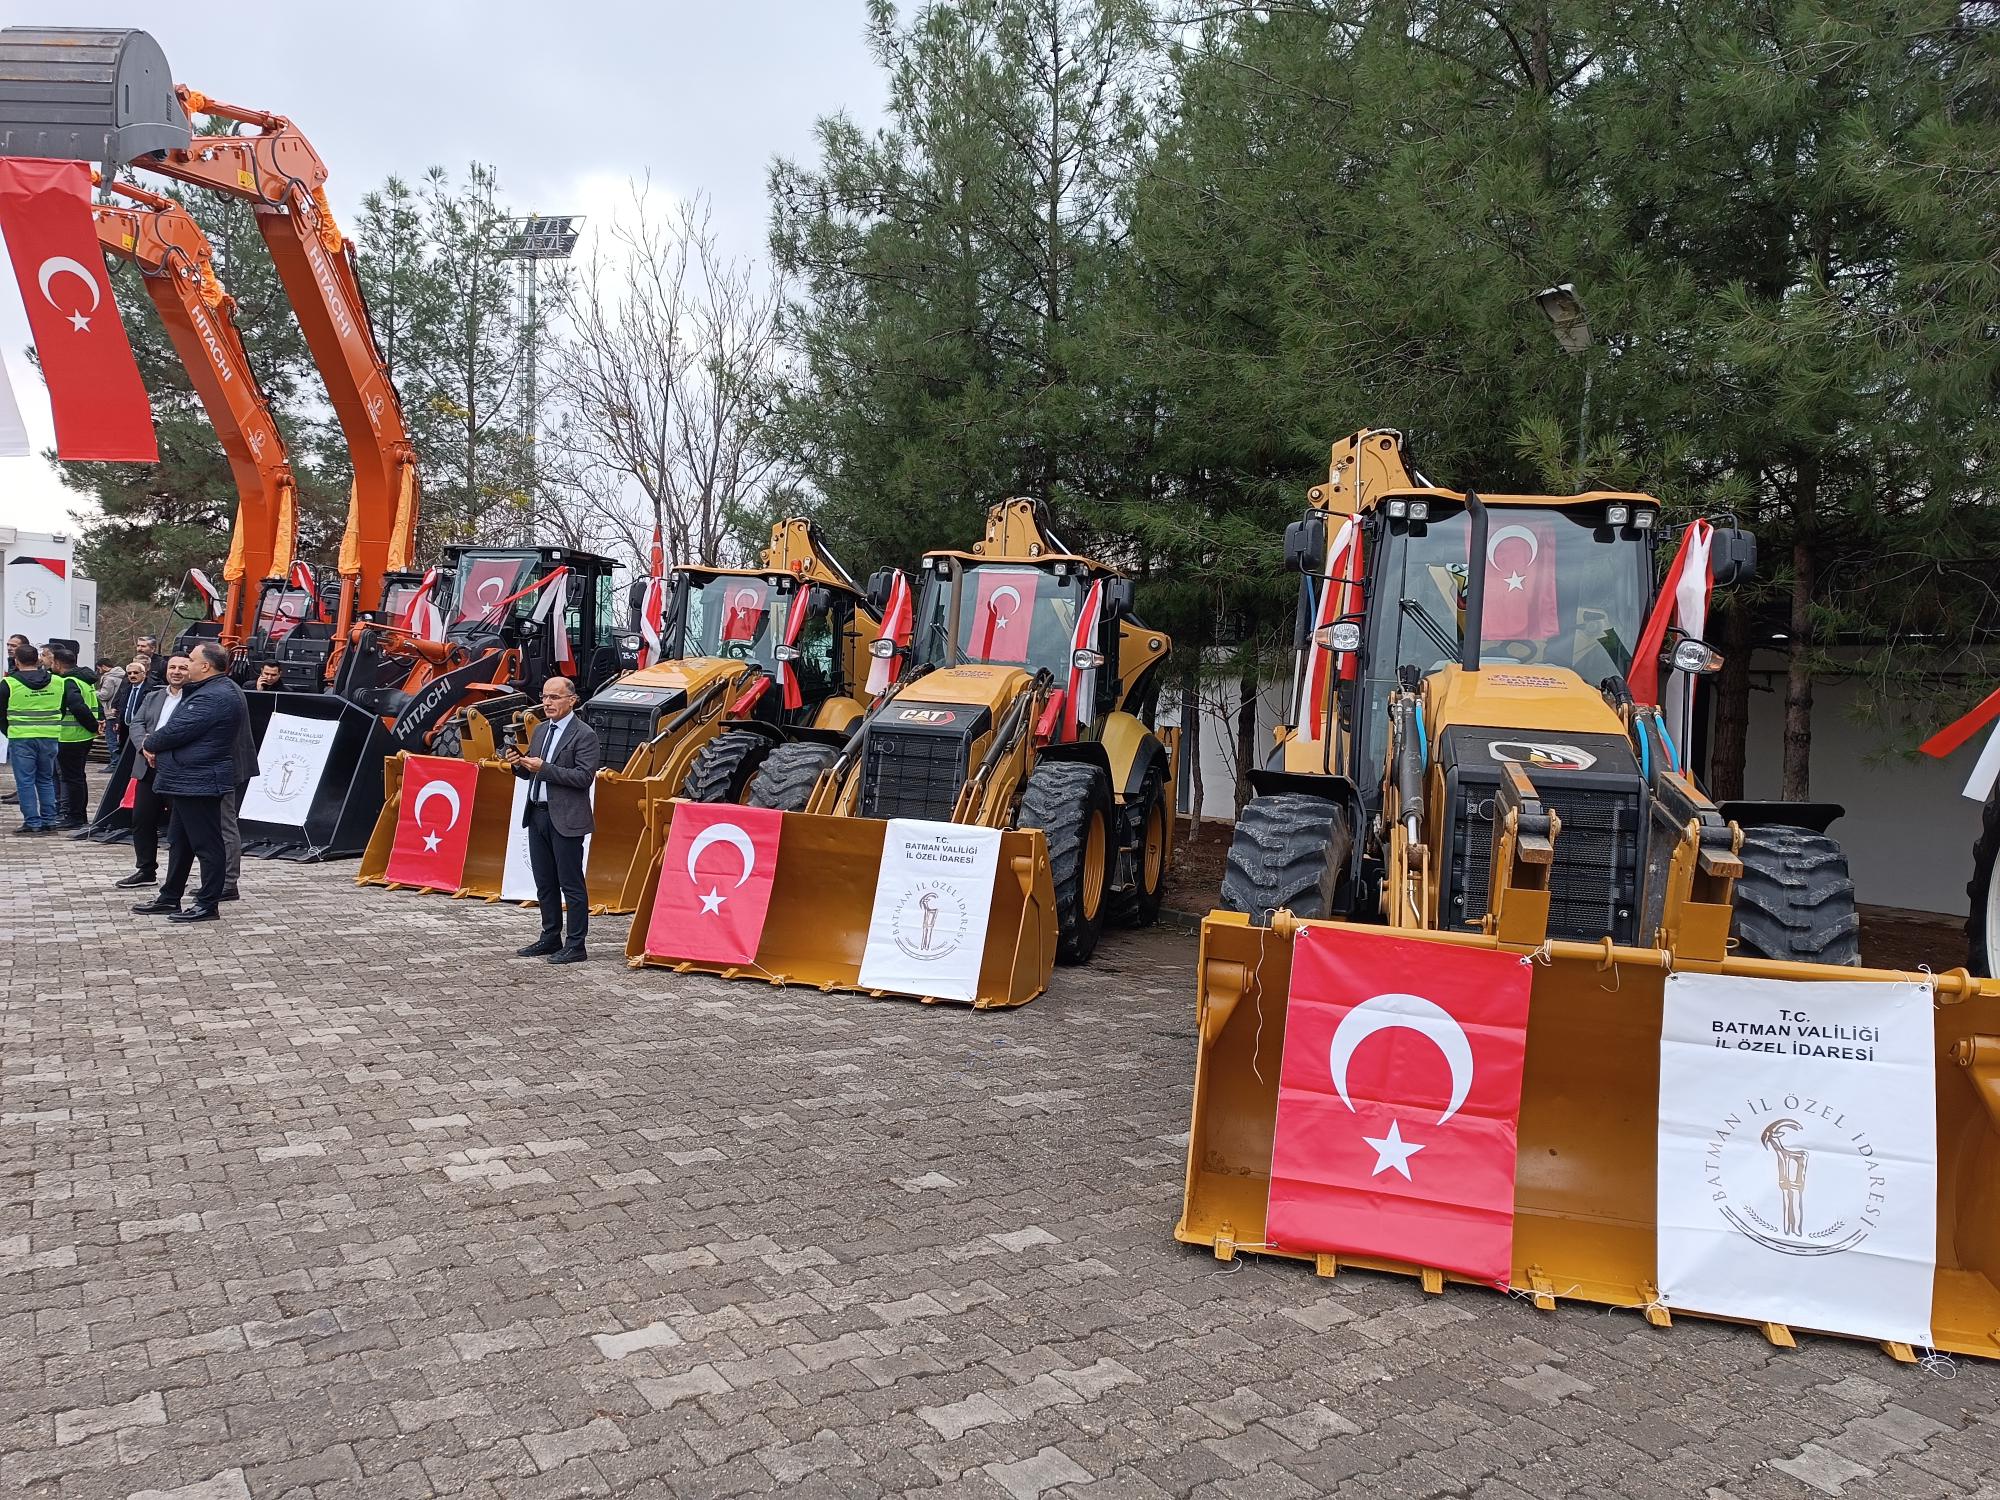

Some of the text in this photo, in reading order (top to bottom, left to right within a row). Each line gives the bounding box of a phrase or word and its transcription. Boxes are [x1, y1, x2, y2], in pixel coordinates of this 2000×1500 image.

[309, 246, 352, 338] HITACHI
[191, 305, 232, 382] HITACHI
[395, 677, 452, 741] HITACHI
[898, 709, 945, 722] CAT
[905, 842, 940, 851] BATMAN
[935, 836, 949, 844] T.C.
[906, 851, 974, 864] İL ÖZEL İDARESİ
[891, 890, 913, 936] BATMAN
[1779, 1009, 1811, 1023] T.C.
[1711, 1020, 1880, 1043] BATMAN VALİLİĞİ
[1715, 1038, 1874, 1062] İL ÖZEL İDARESİ
[1704, 1092, 1887, 1230] BATMAN İL ÖZEL İDARESİ
